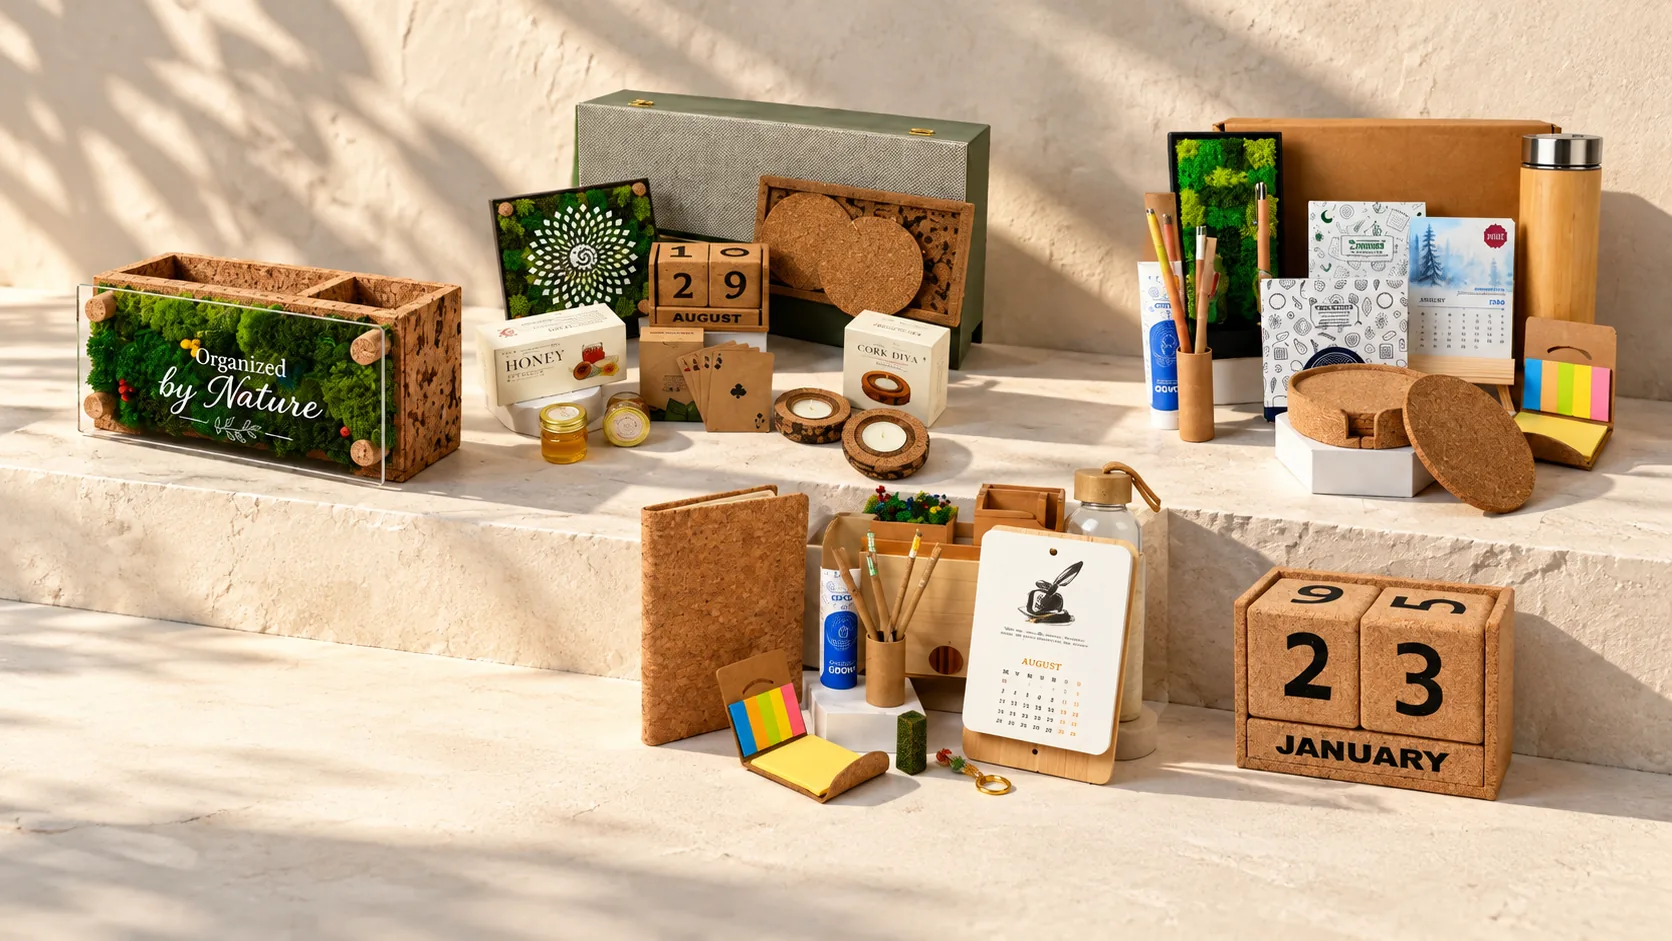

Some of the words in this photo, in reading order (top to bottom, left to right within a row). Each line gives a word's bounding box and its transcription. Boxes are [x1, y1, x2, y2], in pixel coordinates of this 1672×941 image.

[670, 246, 692, 257] 1
[673, 272, 693, 299] 2
[724, 270, 747, 299] 9
[672, 312, 742, 324] AUGUST
[195, 347, 287, 378] Organized
[505, 349, 565, 373] HONEY
[857, 344, 888, 358] CORK
[892, 351, 919, 364] DIYA
[158, 365, 198, 415] by
[203, 374, 324, 419] Nature
[1021, 657, 1062, 671] AUGUST
[1283, 631, 1332, 701] 2
[1395, 641, 1443, 717] 3
[1275, 734, 1450, 773] JANUARY
